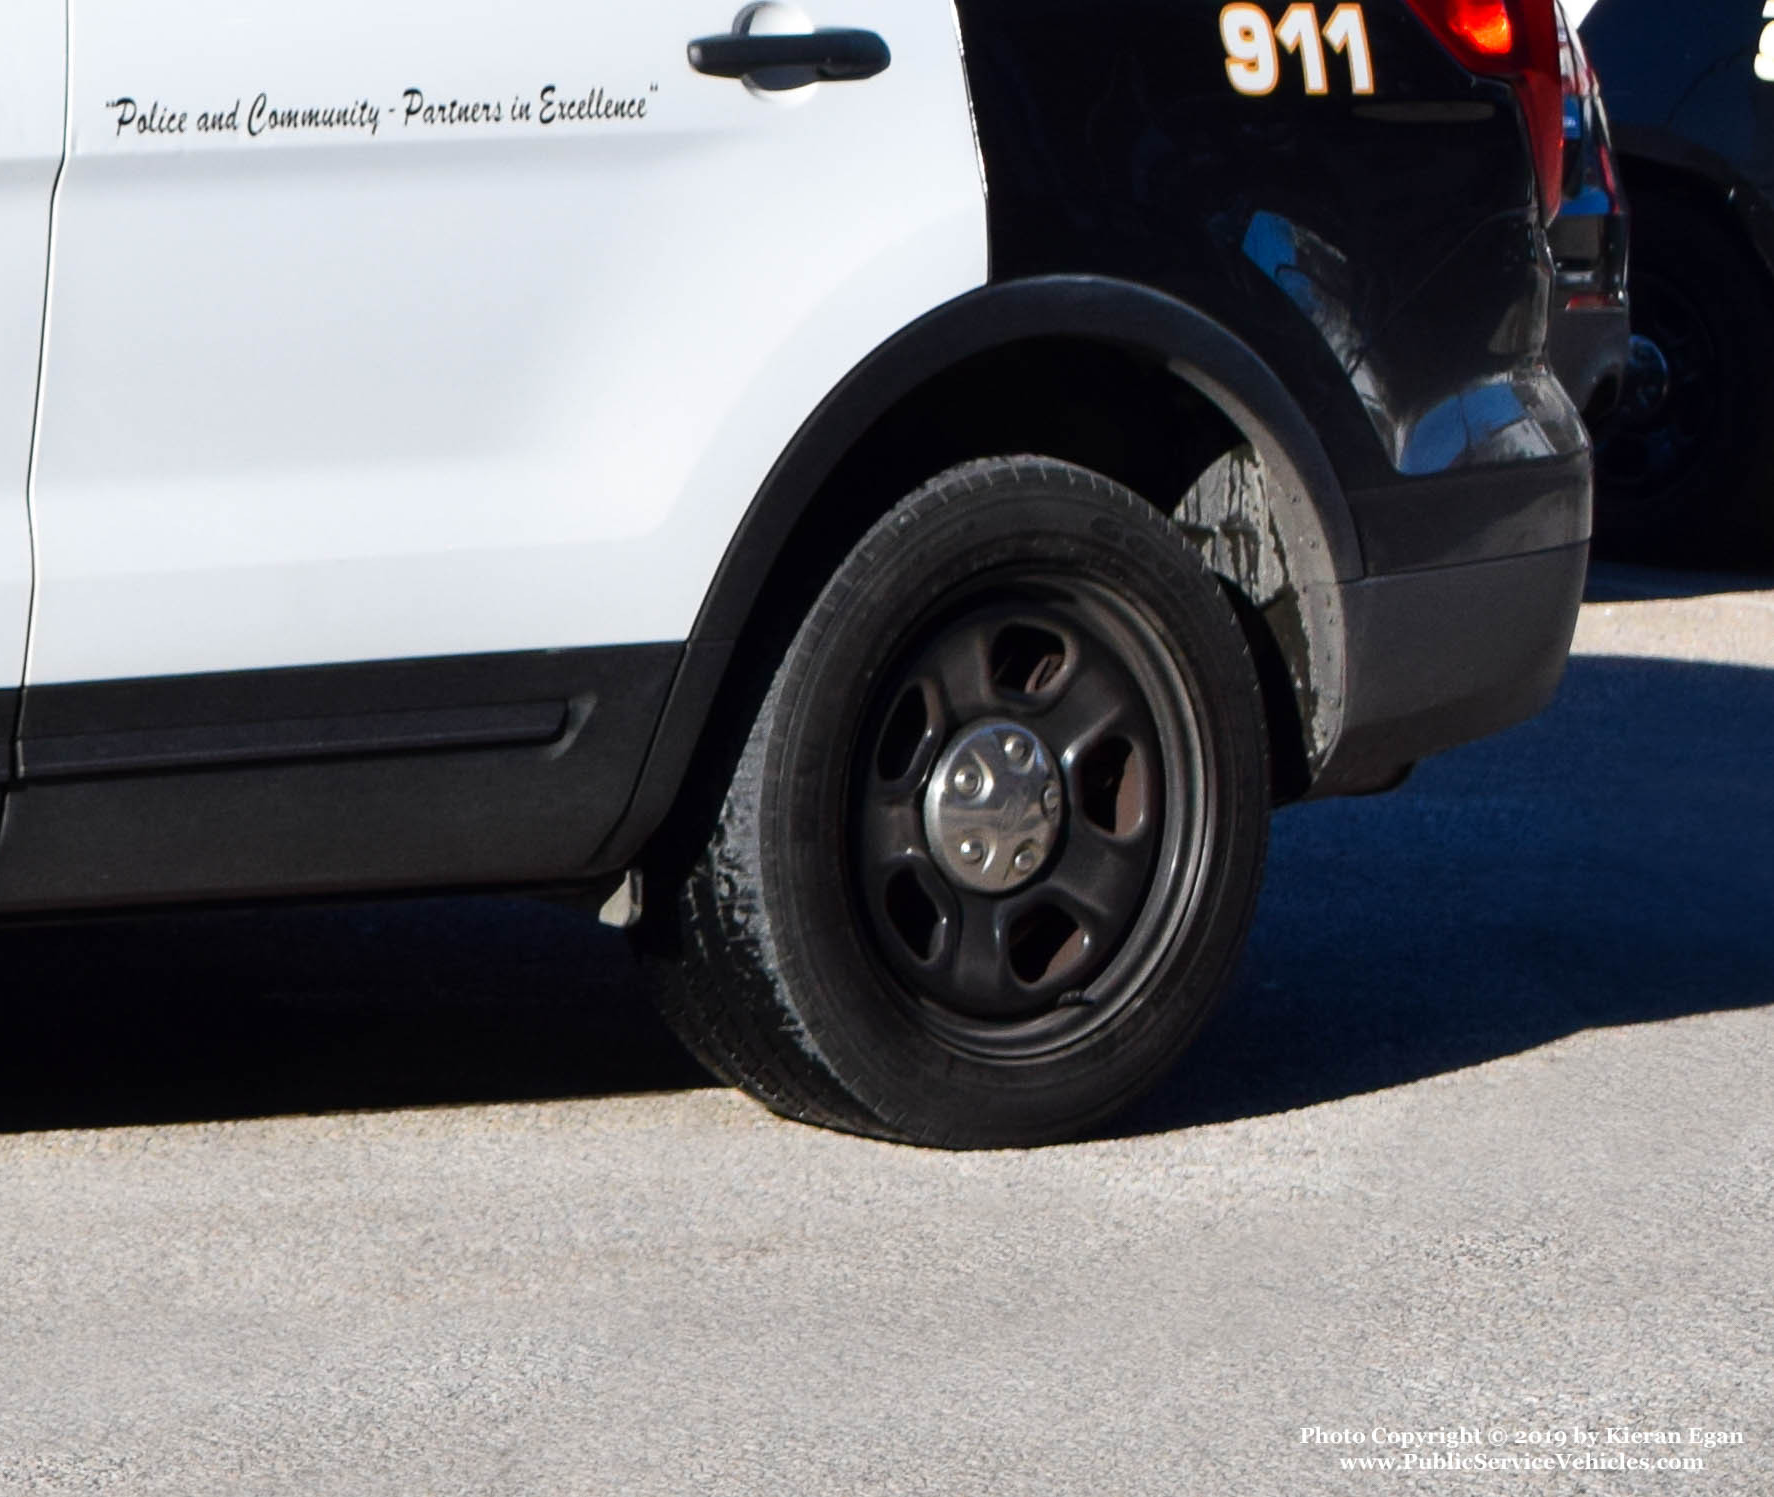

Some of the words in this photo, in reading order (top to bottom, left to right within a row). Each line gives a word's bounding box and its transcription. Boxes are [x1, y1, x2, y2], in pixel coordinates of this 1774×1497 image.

[1219, 2, 1374, 96] 911
[197, 99, 240, 133] and
[248, 92, 380, 136] Community
[403, 87, 502, 126] Partners
[511, 94, 532, 122] in
